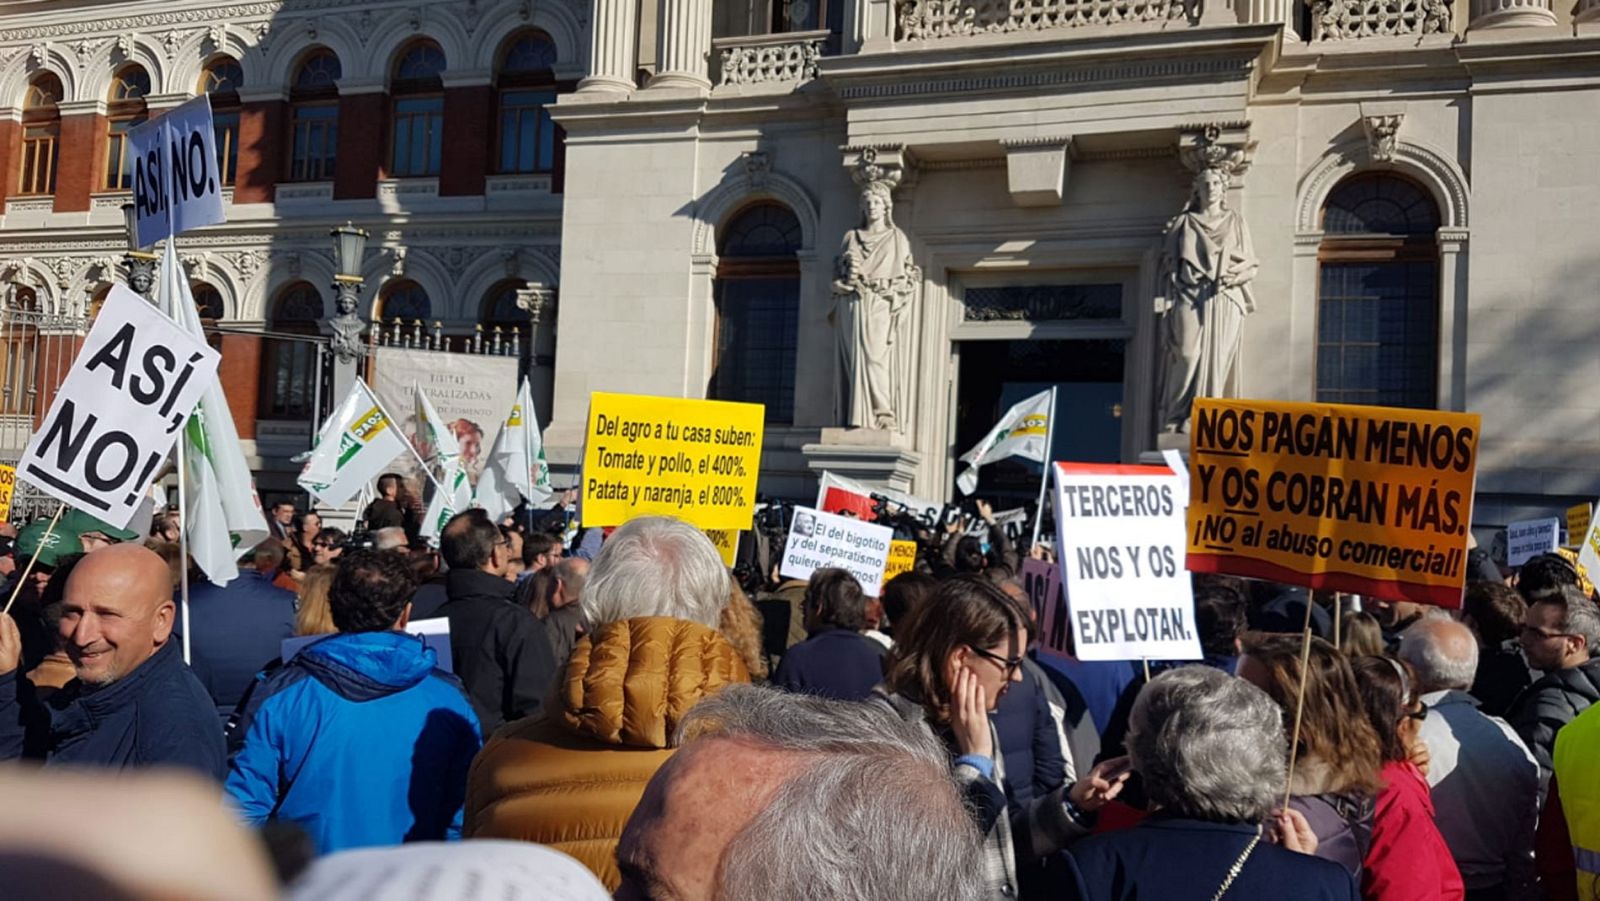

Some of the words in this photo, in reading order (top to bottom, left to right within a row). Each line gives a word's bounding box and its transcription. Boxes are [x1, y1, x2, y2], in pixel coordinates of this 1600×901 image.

[135, 132, 169, 224] ASÍ,
[171, 130, 215, 205] NO.
[85, 322, 204, 434] ASÍ,
[596, 414, 620, 437] Del
[621, 420, 652, 444] agro
[654, 422, 662, 435] a
[665, 420, 679, 441] tu
[682, 424, 712, 443] casa
[715, 425, 756, 447] suben:
[1196, 406, 1255, 452] NOS
[1260, 409, 1359, 461] PAGAN
[1364, 416, 1473, 474] MENOS
[35, 398, 162, 507] NO!
[597, 446, 645, 470] Tomate
[646, 454, 657, 476] y
[658, 451, 695, 477] pollo,
[698, 454, 711, 473] el
[712, 455, 747, 477] 400%.
[588, 478, 629, 500] Patata
[630, 485, 641, 507] y
[643, 484, 695, 509] naranja,
[698, 485, 711, 505] el
[712, 485, 747, 508] 800%.
[1063, 484, 1174, 518] TERCEROS
[1197, 464, 1217, 504] Y
[1221, 465, 1260, 510] OS
[1266, 470, 1390, 527] COBRAN
[1395, 478, 1465, 537] MÁS.
[790, 538, 799, 550] y
[800, 537, 818, 551] del
[819, 544, 883, 568] separatismo
[815, 523, 827, 536] El
[828, 526, 845, 540] del
[846, 531, 886, 551] bigotito
[1193, 513, 1237, 547] ¡NO
[1241, 521, 1264, 548] al
[1266, 520, 1334, 559] abuso
[1338, 539, 1463, 578] comercial!
[788, 553, 822, 569] quiere
[1076, 546, 1123, 580] NOS
[1126, 546, 1141, 579] Y
[1148, 545, 1176, 579] OS
[1077, 607, 1192, 644] EXPLOTAN.
